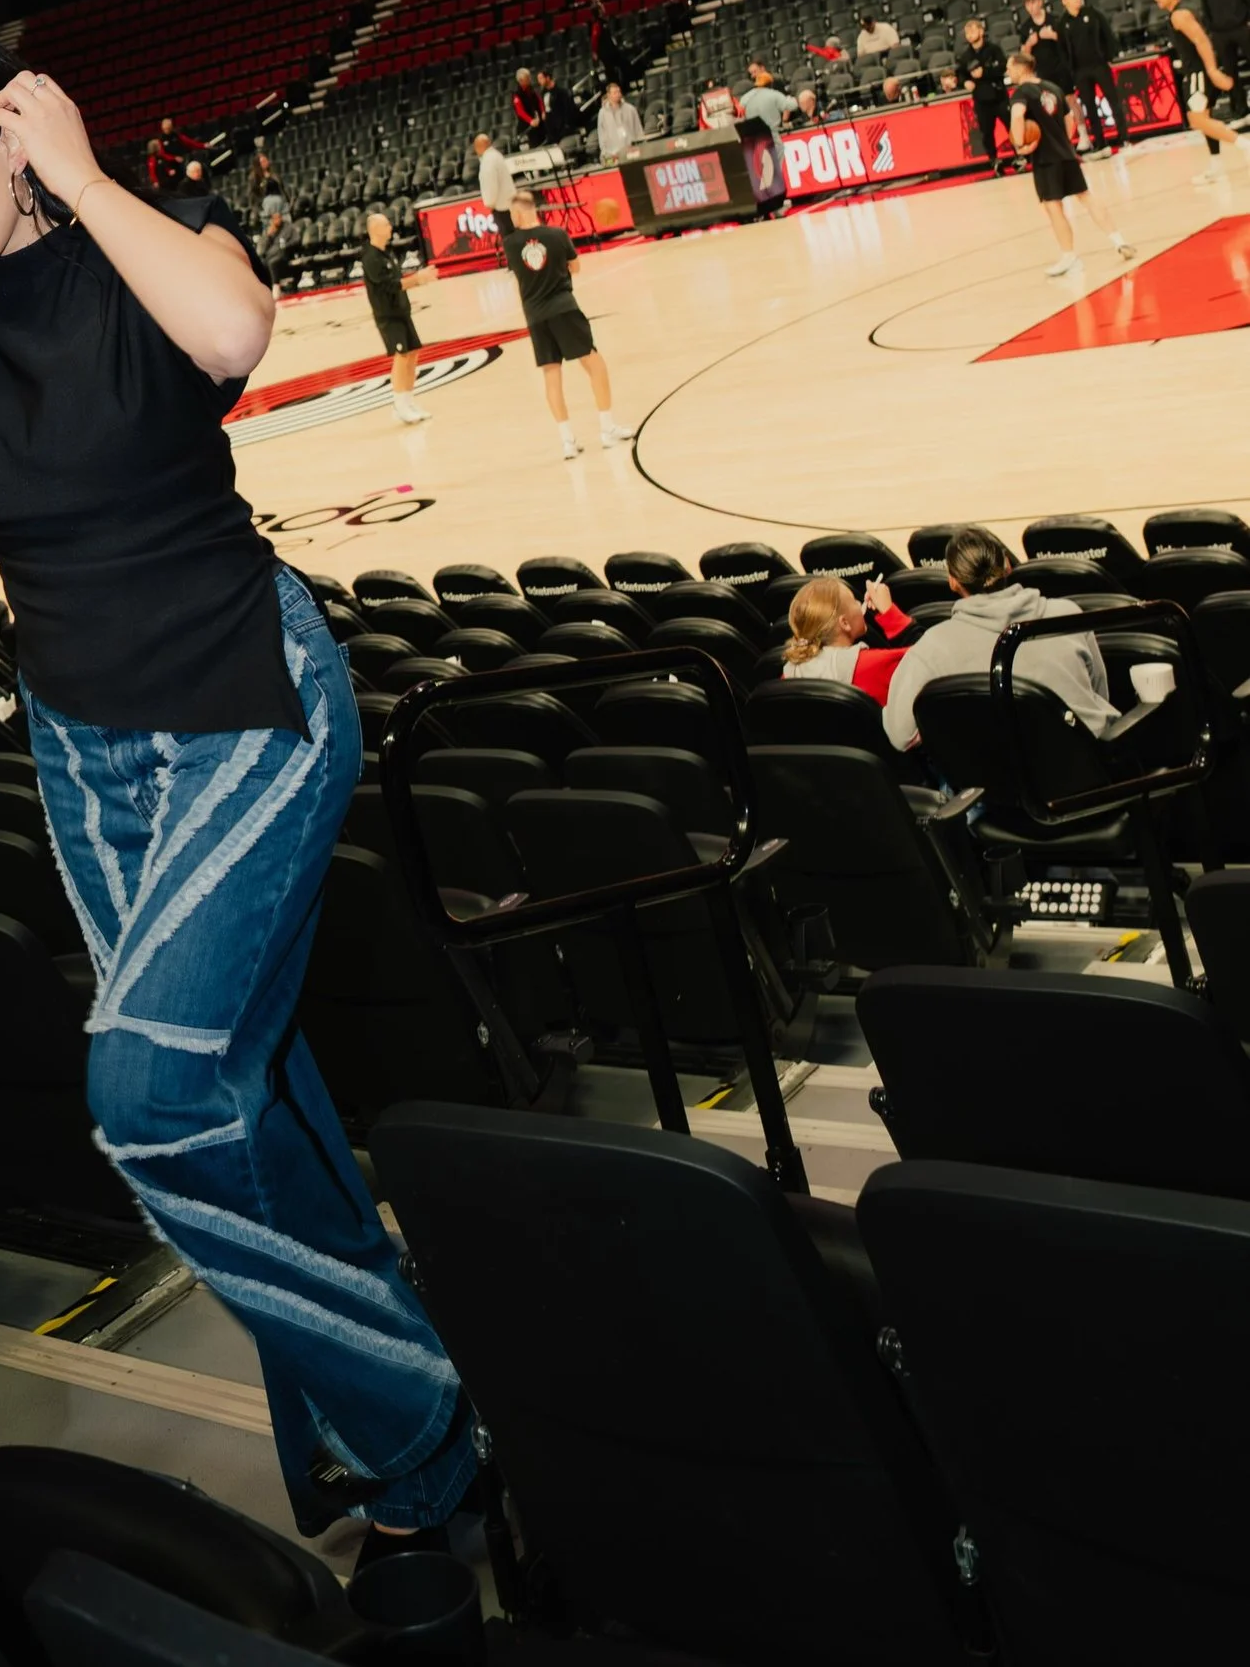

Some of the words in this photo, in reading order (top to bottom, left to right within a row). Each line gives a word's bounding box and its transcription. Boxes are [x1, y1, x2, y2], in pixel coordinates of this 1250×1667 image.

[782, 128, 866, 190] POR
[665, 160, 702, 185] LON
[671, 181, 709, 208] POR
[525, 582, 578, 597] ticketmaster
